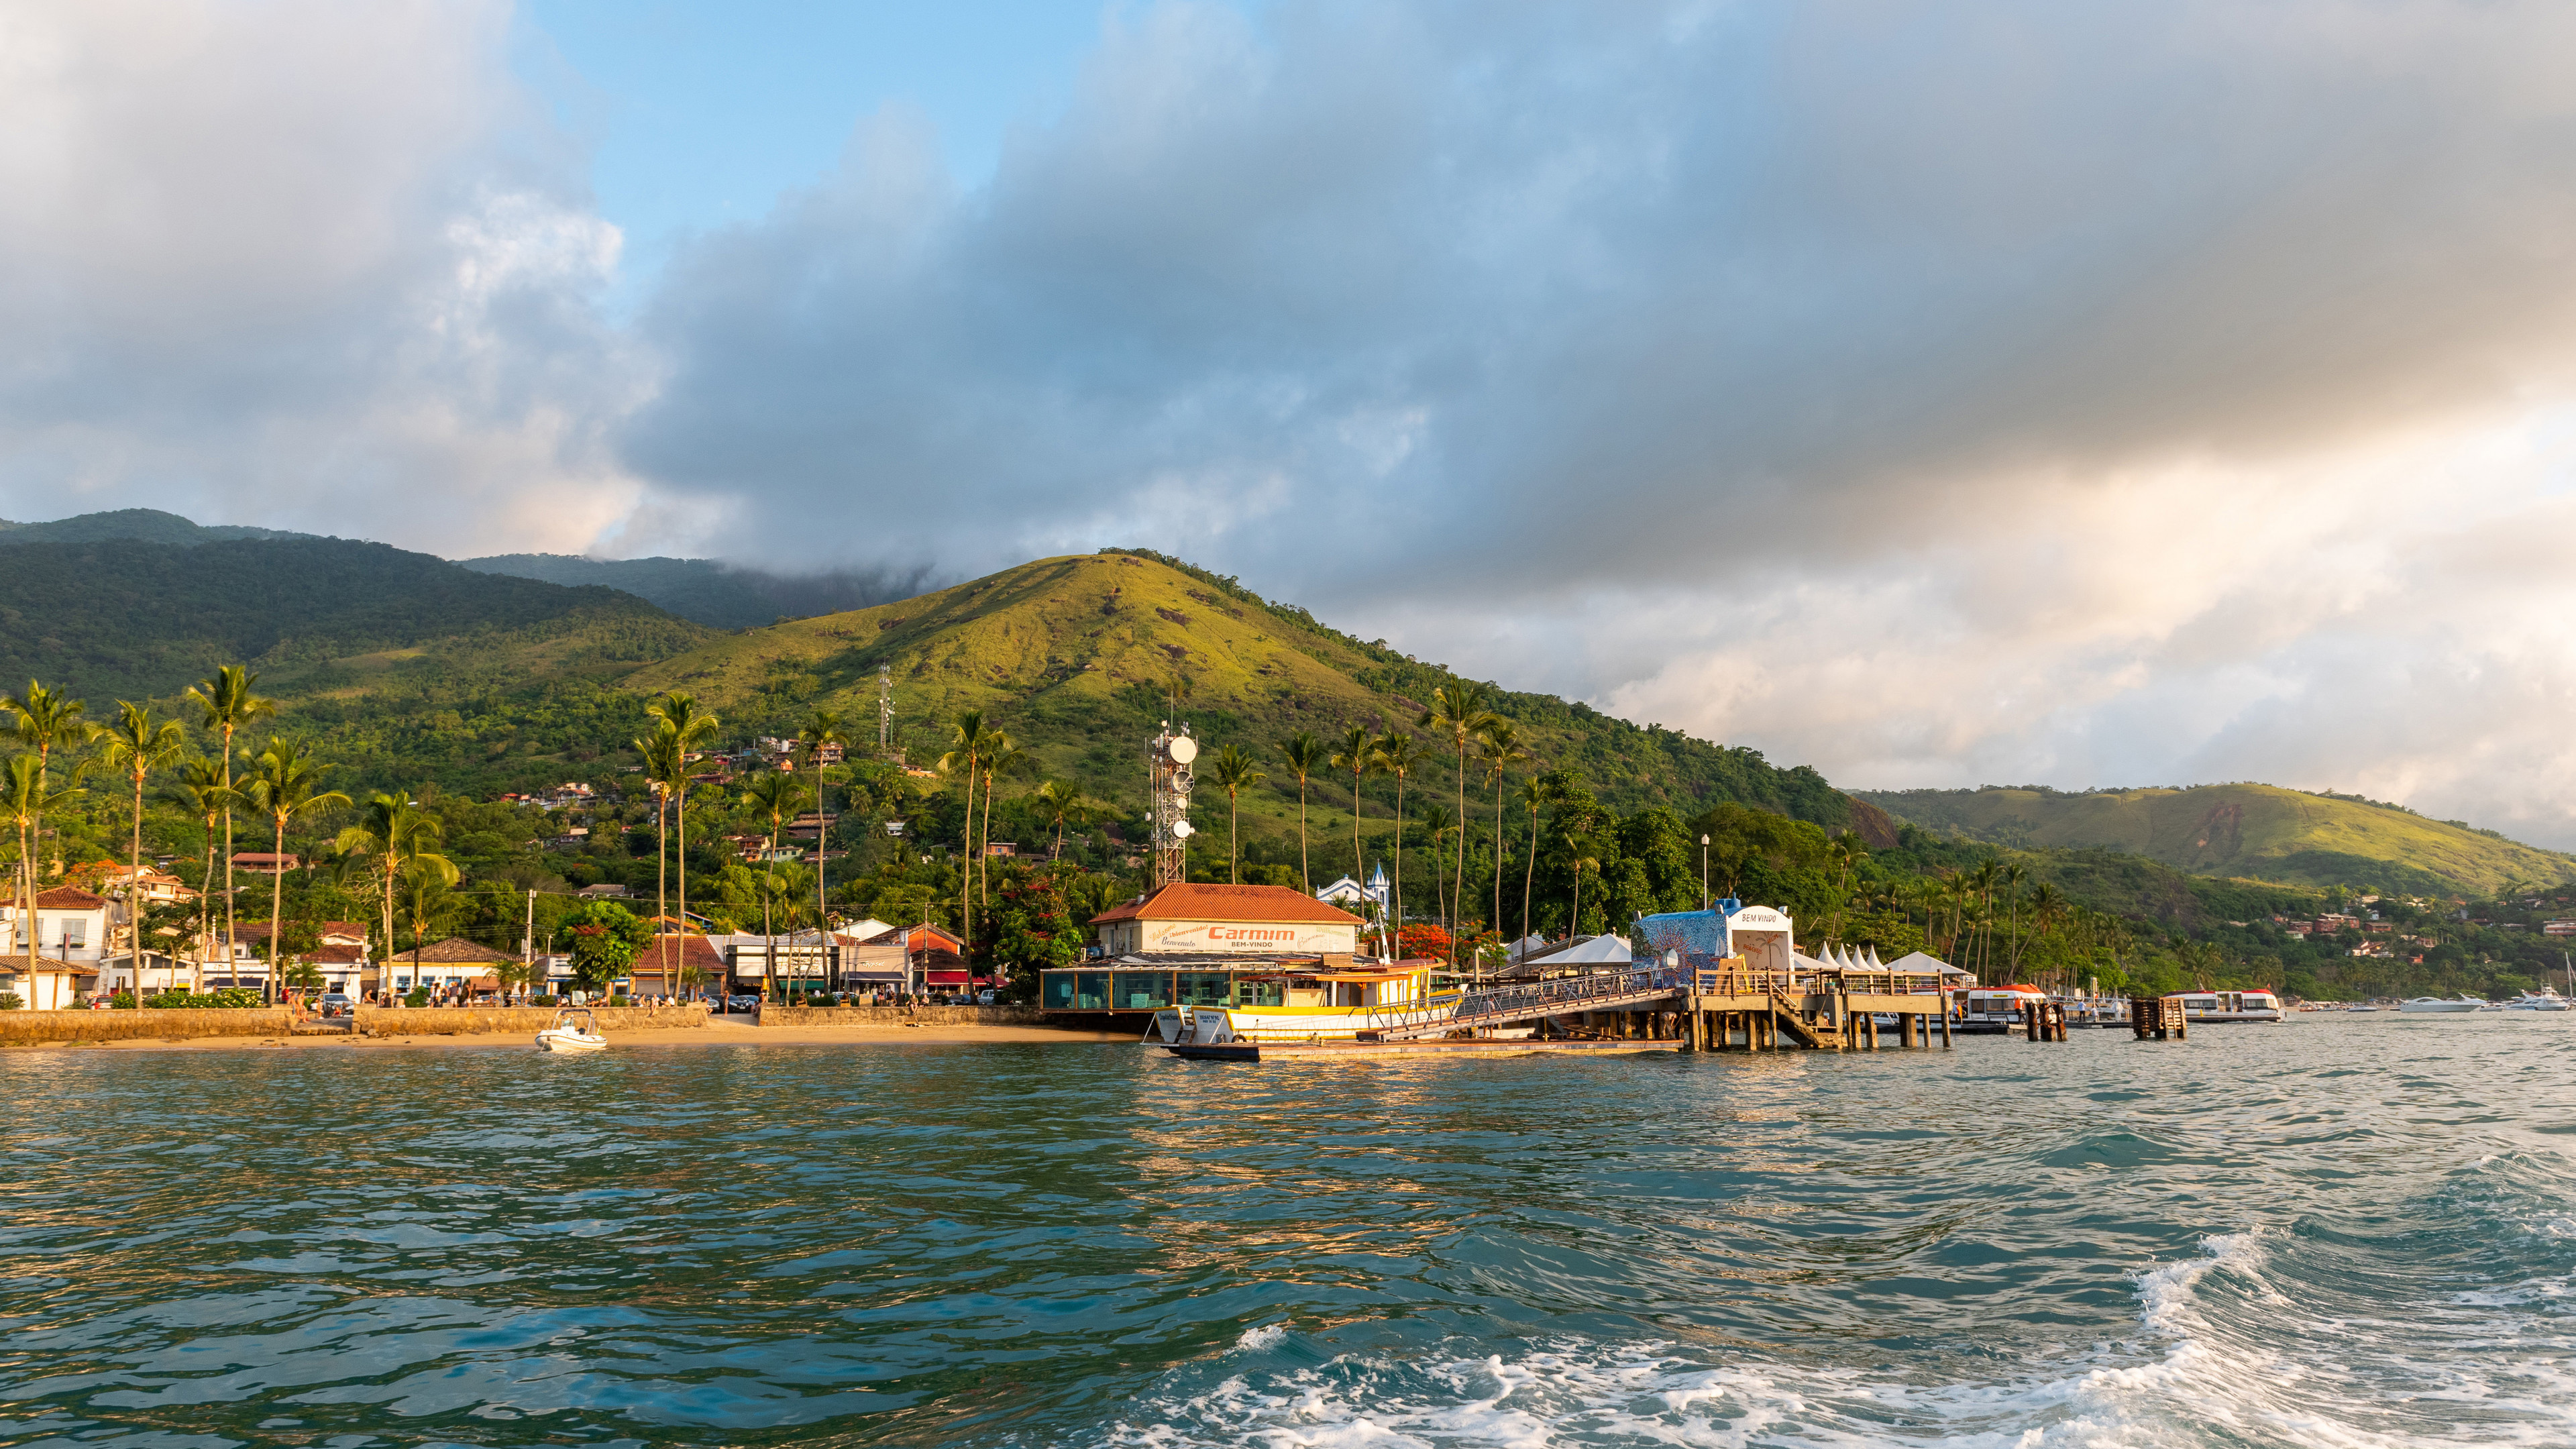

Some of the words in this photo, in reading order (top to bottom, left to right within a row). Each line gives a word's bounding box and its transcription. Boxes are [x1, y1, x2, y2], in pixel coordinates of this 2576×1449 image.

[1742, 914, 1756, 922] BEM
[1758, 914, 1776, 922] VINDO
[1149, 923, 1176, 942] Welcome
[1208, 926, 1295, 941] Carmim
[1161, 936, 1196, 947] Benvenuto
